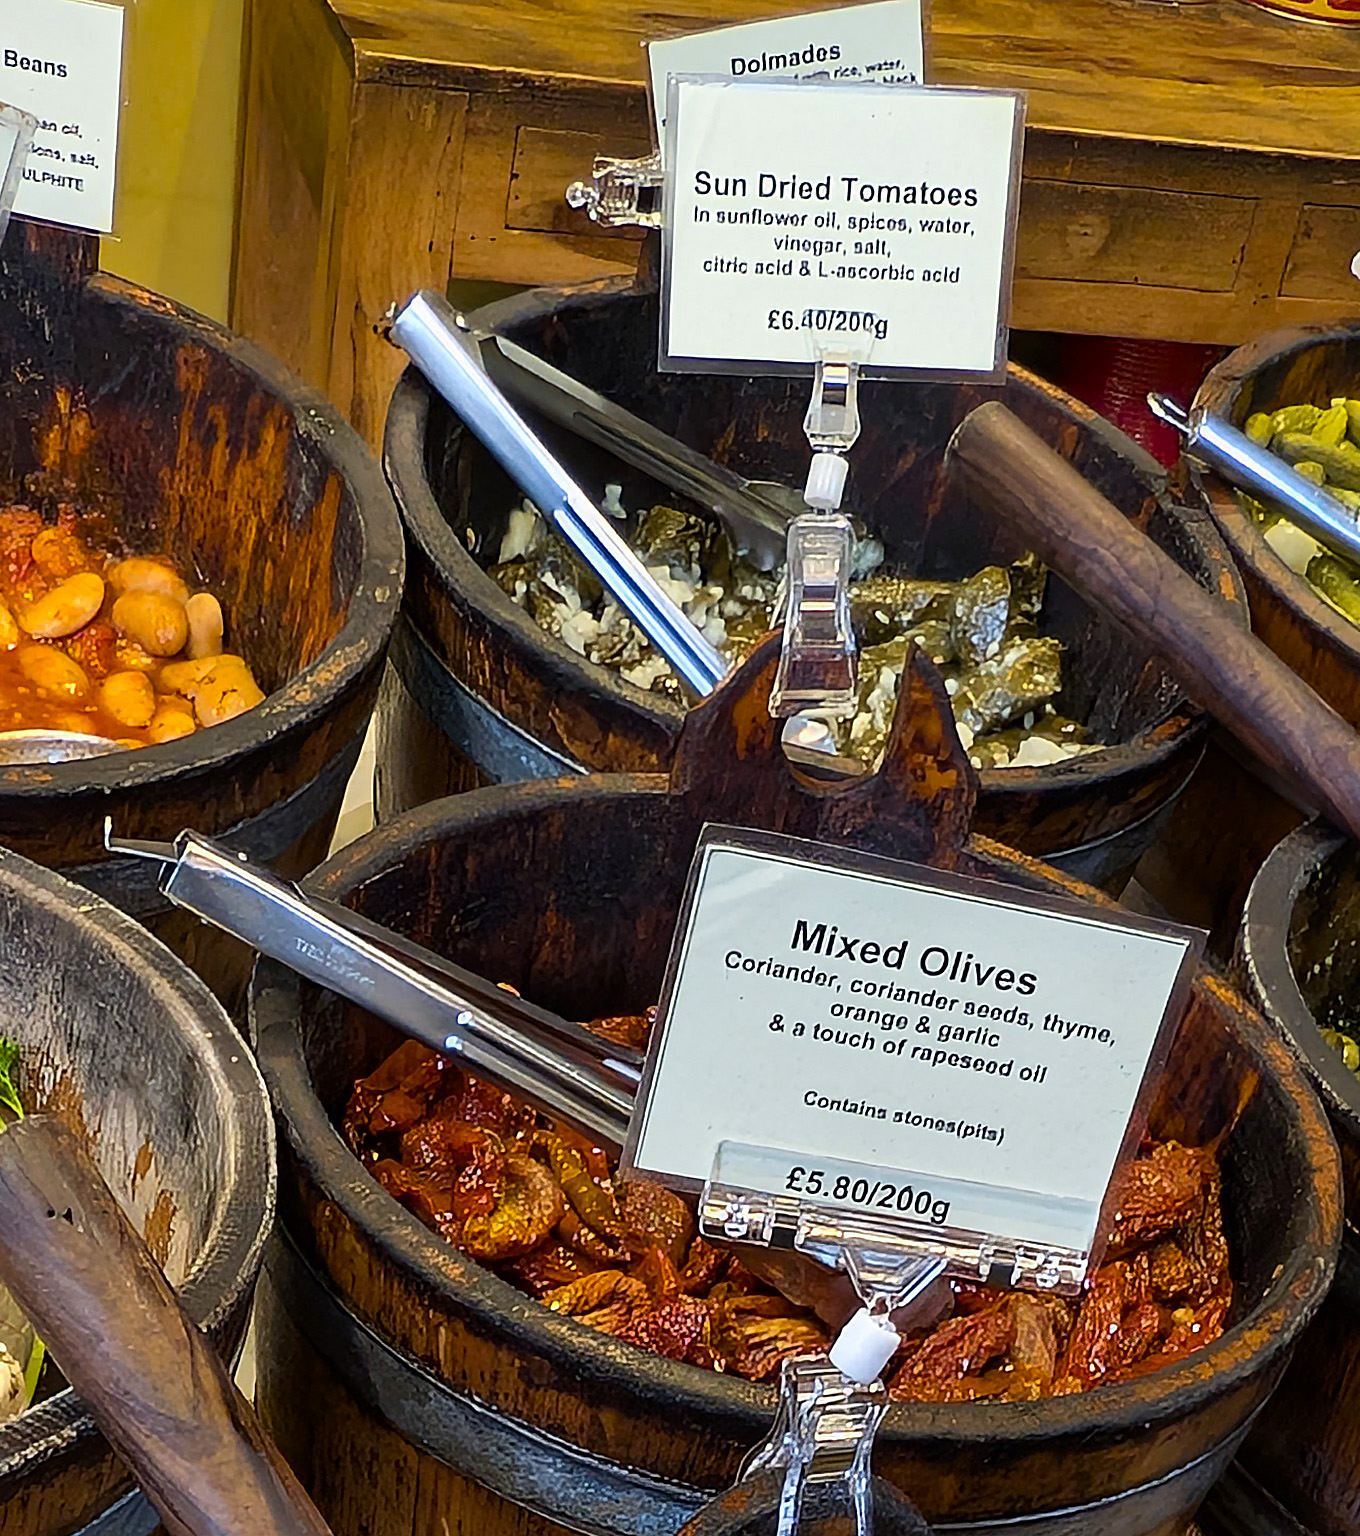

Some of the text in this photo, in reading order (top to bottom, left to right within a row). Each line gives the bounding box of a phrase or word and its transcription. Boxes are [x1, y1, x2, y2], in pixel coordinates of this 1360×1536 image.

[4, 49, 68, 78] Beans
[21, 166, 85, 193] ULPHITE
[694, 170, 978, 207] Sun Dried Tomatoes
[694, 205, 975, 237] In sunflower oil, spices, water,
[773, 234, 891, 259] vinegar, salt,
[703, 255, 961, 284] citric acid & L-ascorbic acid
[790, 919, 1038, 996] Mixed Olives
[724, 950, 1115, 1048] Coriander, coriander seeds, thyme,
[830, 1003, 1000, 1048] orange & garlic
[768, 1014, 1048, 1084] & a touch of rapeseed oil
[803, 1090, 1005, 1147] Contains stones(pits)
[784, 1166, 952, 1225] £5.80/200g
